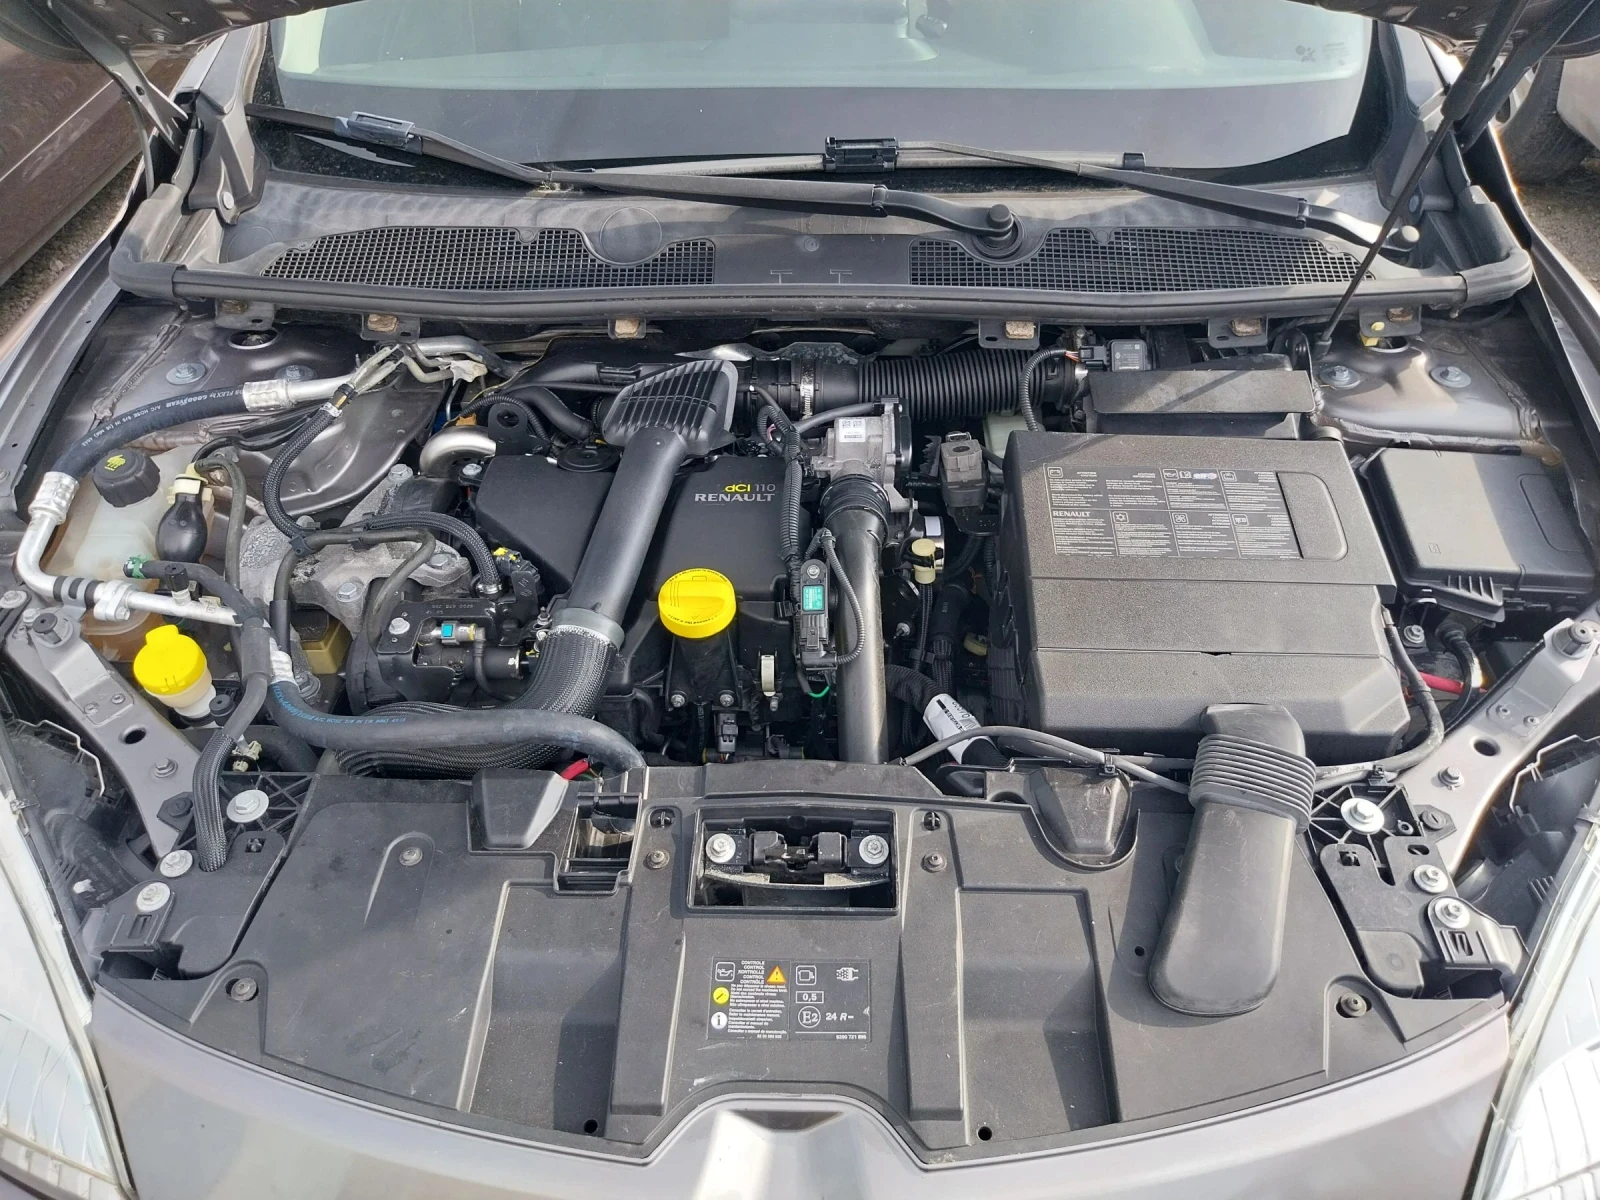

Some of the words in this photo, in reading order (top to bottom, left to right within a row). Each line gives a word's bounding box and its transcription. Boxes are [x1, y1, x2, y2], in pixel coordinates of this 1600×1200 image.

[166, 394, 208, 408] GOODYEAR
[132, 408, 149, 420] HOSE
[755, 484, 776, 492] 110
[694, 494, 775, 502] RENAULT
[802, 993, 817, 1002] 0,5
[802, 1011, 818, 1024] E2
[826, 1012, 837, 1020] 24
